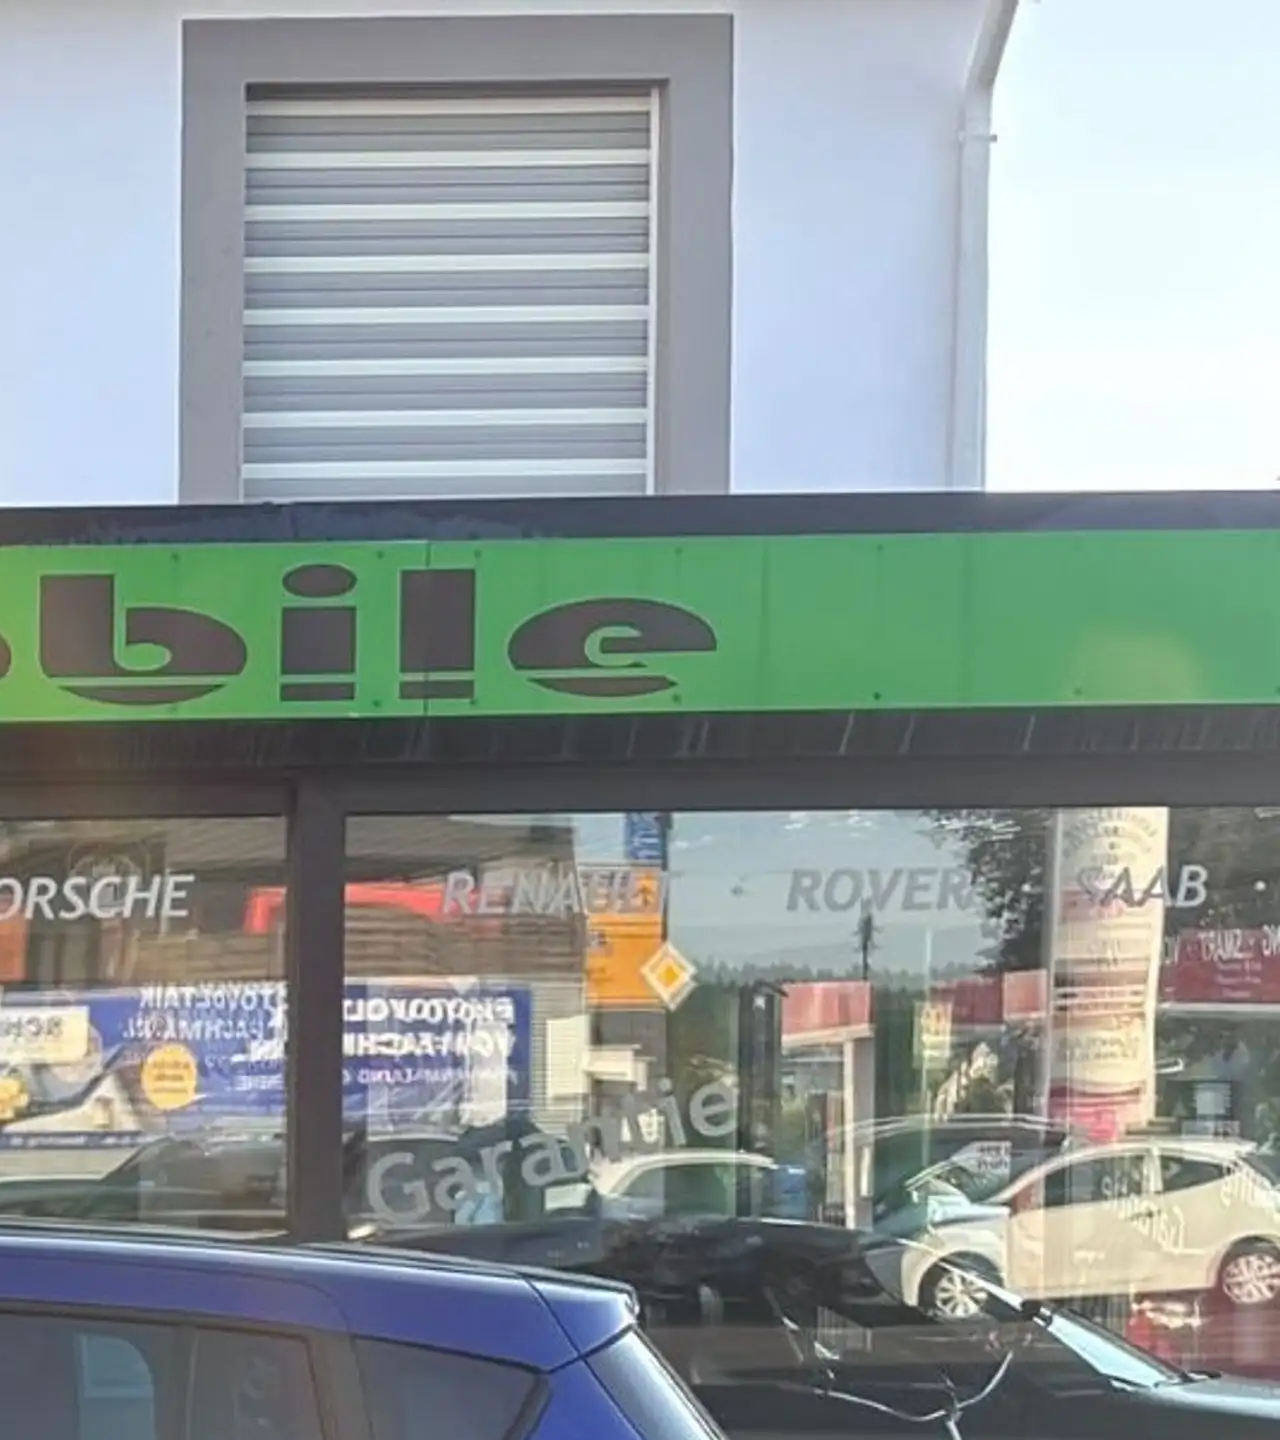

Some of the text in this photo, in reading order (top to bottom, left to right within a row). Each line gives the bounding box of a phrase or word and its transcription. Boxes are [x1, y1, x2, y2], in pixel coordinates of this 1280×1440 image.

[785, 868, 977, 912] ROVER
[1077, 863, 1209, 910] SAAB
[367, 1075, 739, 1223] Garantie
